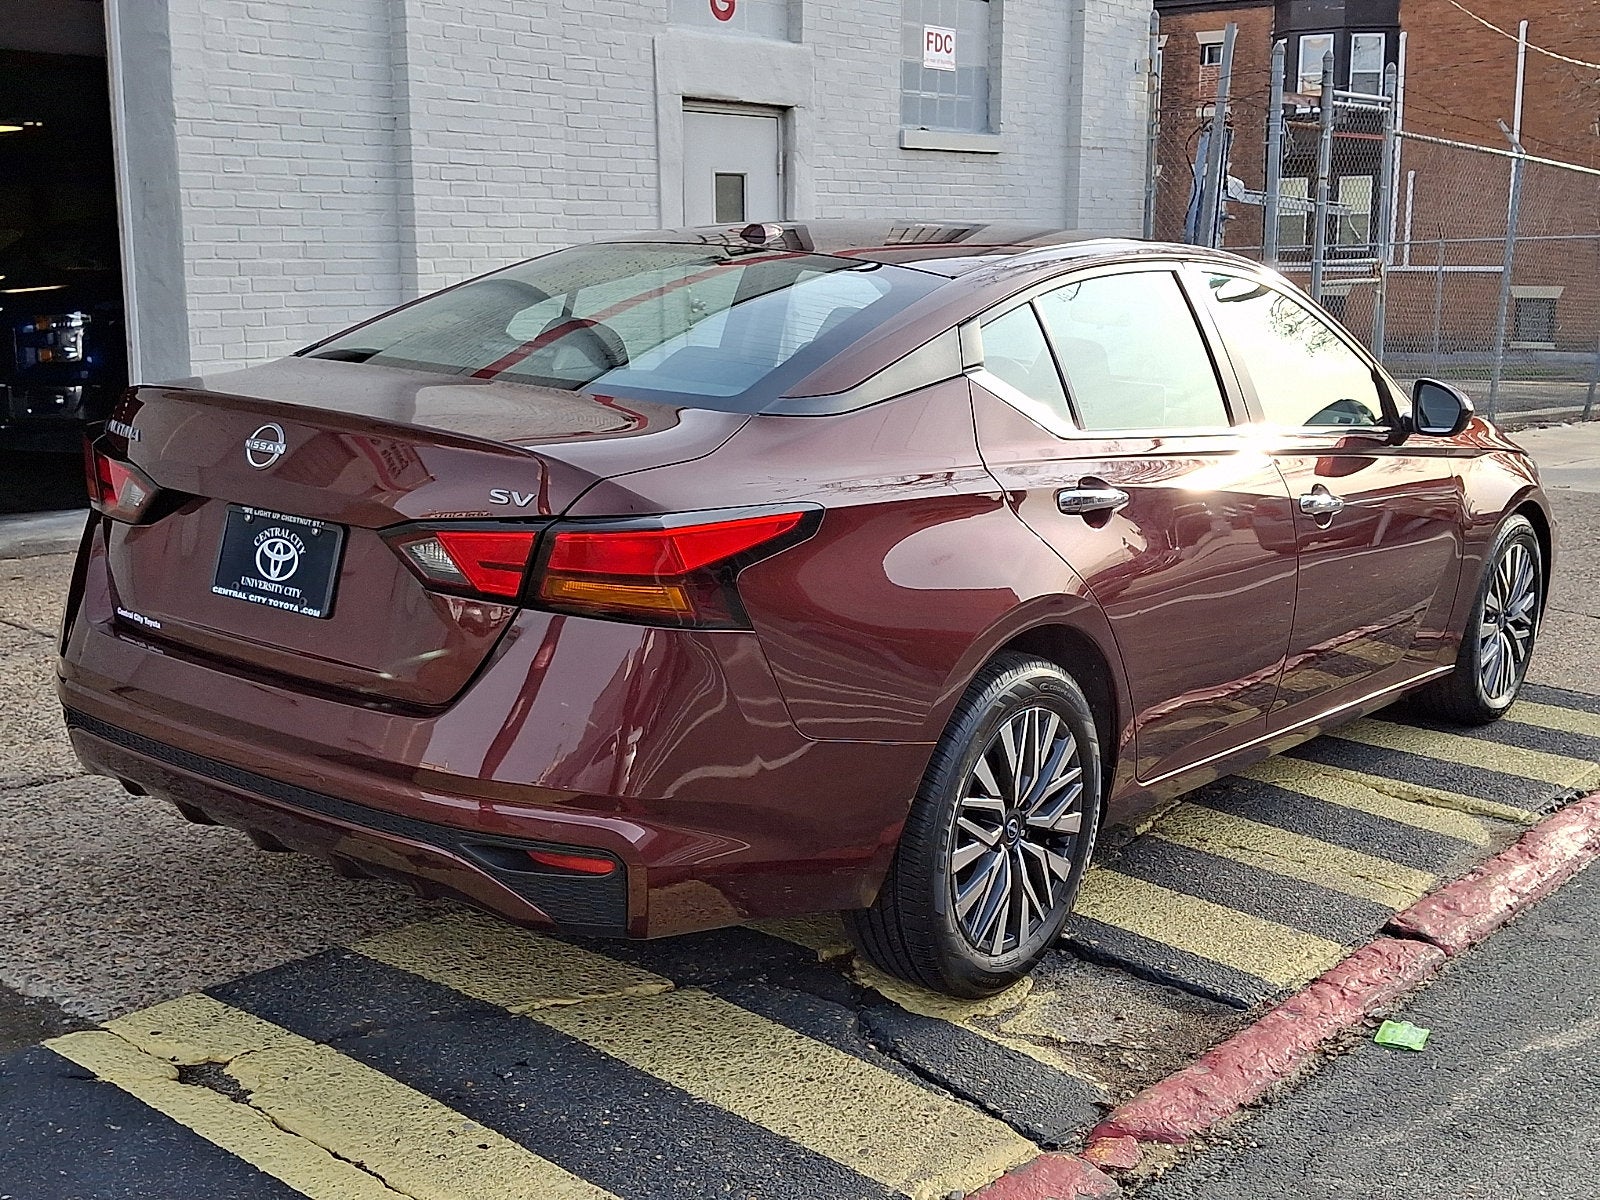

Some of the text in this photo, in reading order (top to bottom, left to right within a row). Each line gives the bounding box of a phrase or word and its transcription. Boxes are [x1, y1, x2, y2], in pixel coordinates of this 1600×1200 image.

[926, 31, 953, 54] FDC
[245, 439, 286, 454] NISSAN
[488, 488, 536, 507] SV
[254, 509, 272, 518] LIGHT
[272, 512, 281, 520] UP
[281, 514, 313, 526] CHESTNUT
[253, 527, 307, 555] CENTRAL CITY
[241, 576, 302, 599] UNIVERSITY CITY
[212, 586, 248, 600] CENTRAL
[248, 594, 267, 604] CITY
[268, 599, 299, 612] TOYOTA
[144, 616, 161, 630] Toyota
